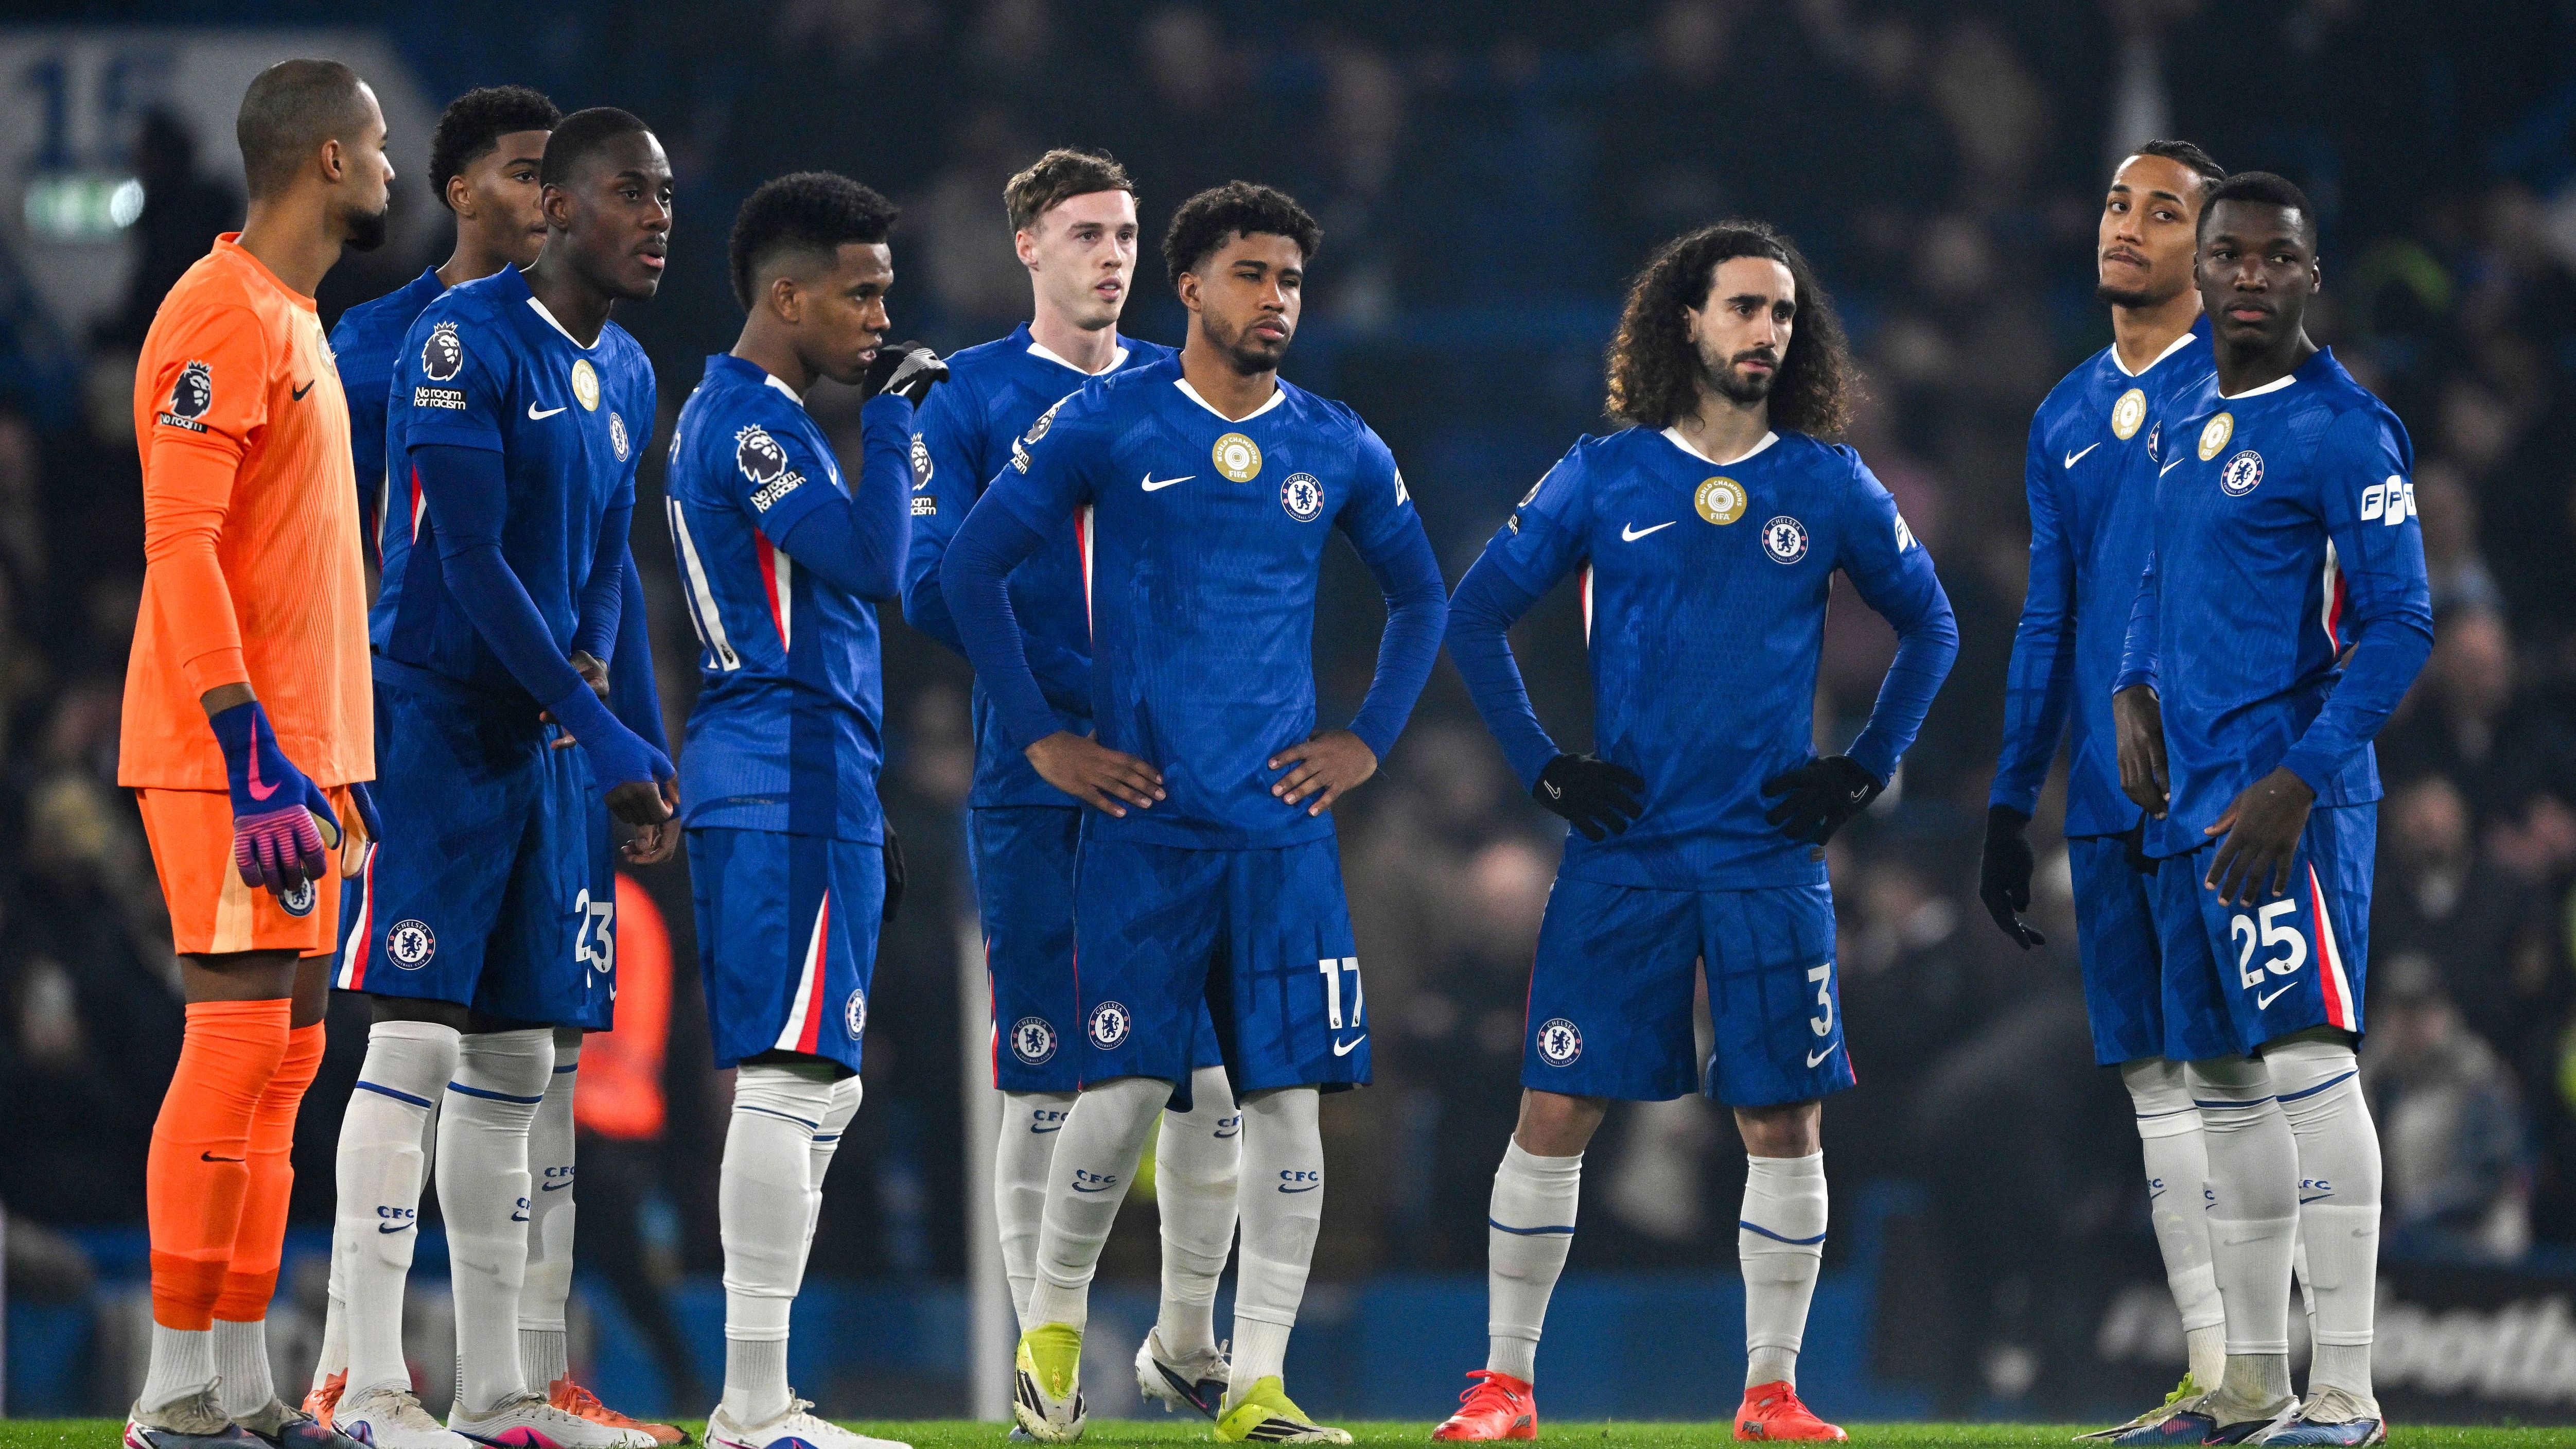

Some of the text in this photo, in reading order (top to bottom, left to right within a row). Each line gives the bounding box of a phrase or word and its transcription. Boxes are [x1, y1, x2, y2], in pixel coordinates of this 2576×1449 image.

[415, 387, 461, 400] No room
[430, 398, 466, 410] racism
[1217, 437, 1257, 464] WORLD CHAMPIONS
[2237, 452, 2261, 465] CHELSEA
[1288, 475, 1317, 486] CHELSEA
[749, 471, 797, 507] No room
[772, 477, 807, 502] racism
[1699, 480, 1743, 507] WORLD CHAMPIONS
[1771, 518, 1800, 531] CHELSEA
[396, 921, 428, 933] CHELSEA
[2232, 898, 2307, 990] 25
[1319, 957, 1363, 1029] 17
[1808, 962, 1833, 1037] 3
[1095, 1003, 1123, 1015] CHELSEA
[1018, 1018, 1047, 1028] CHELSEA
[1547, 1020, 1575, 1033] CHELSEA
[1076, 1169, 1116, 1183] CFC
[1280, 1170, 1318, 1181] CFC
[377, 1206, 415, 1219] CFC
